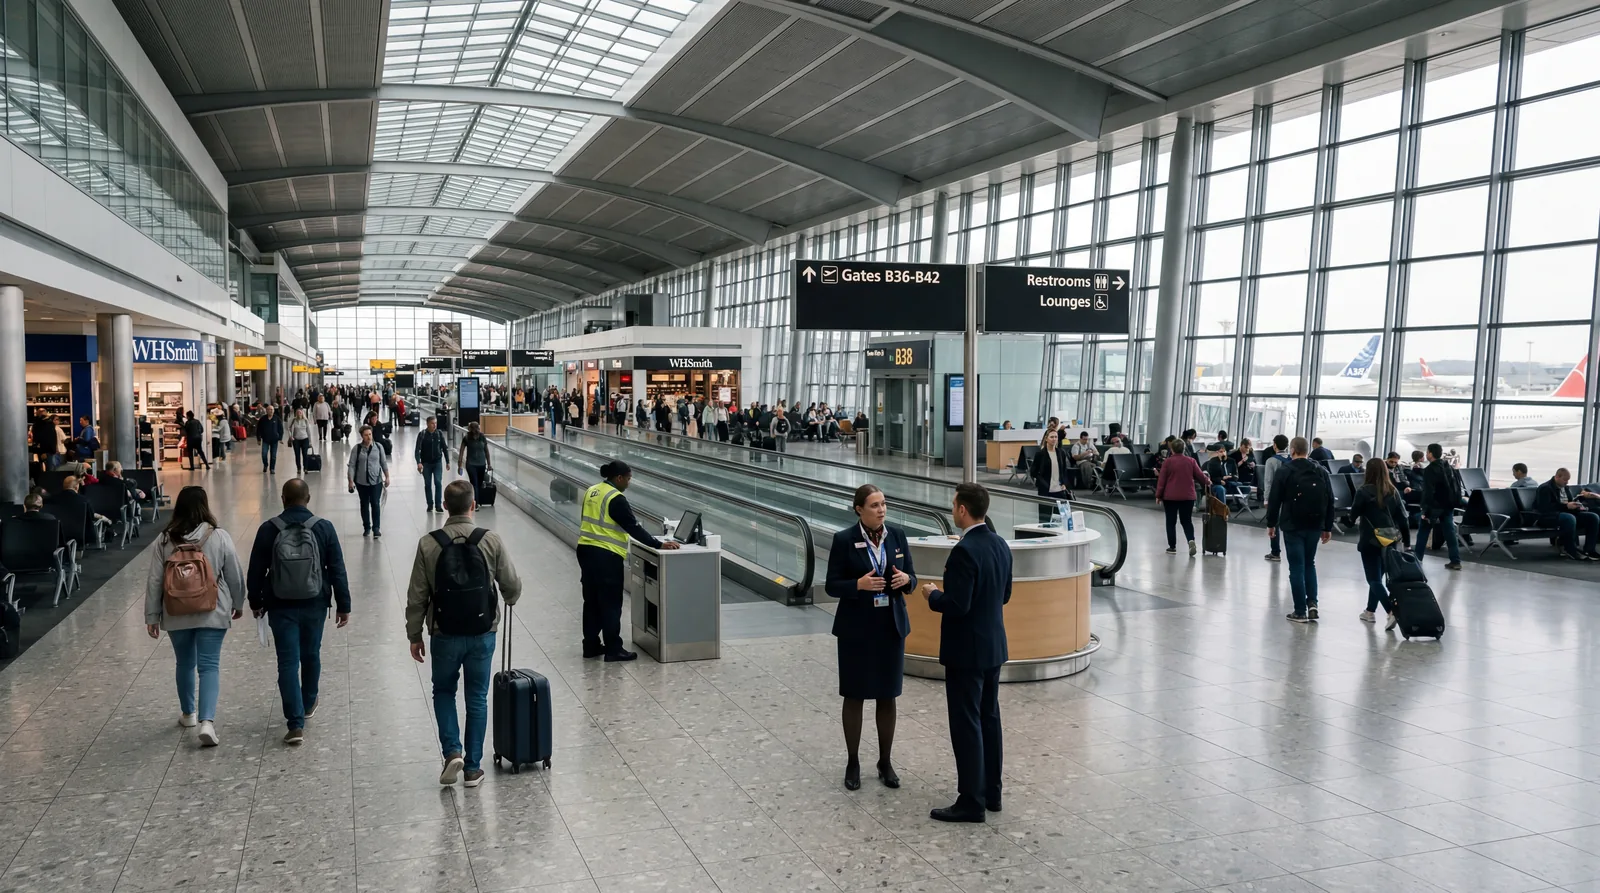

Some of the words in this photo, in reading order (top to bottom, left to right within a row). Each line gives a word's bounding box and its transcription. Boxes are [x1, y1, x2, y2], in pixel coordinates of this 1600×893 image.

[842, 269, 881, 282] Gates
[885, 270, 940, 284] B36-B42
[1027, 274, 1091, 287] Restrooms
[1040, 295, 1091, 310] Lounges
[132, 339, 199, 361] WHSmith
[895, 348, 913, 365] B38
[669, 358, 713, 368] WHSmith
